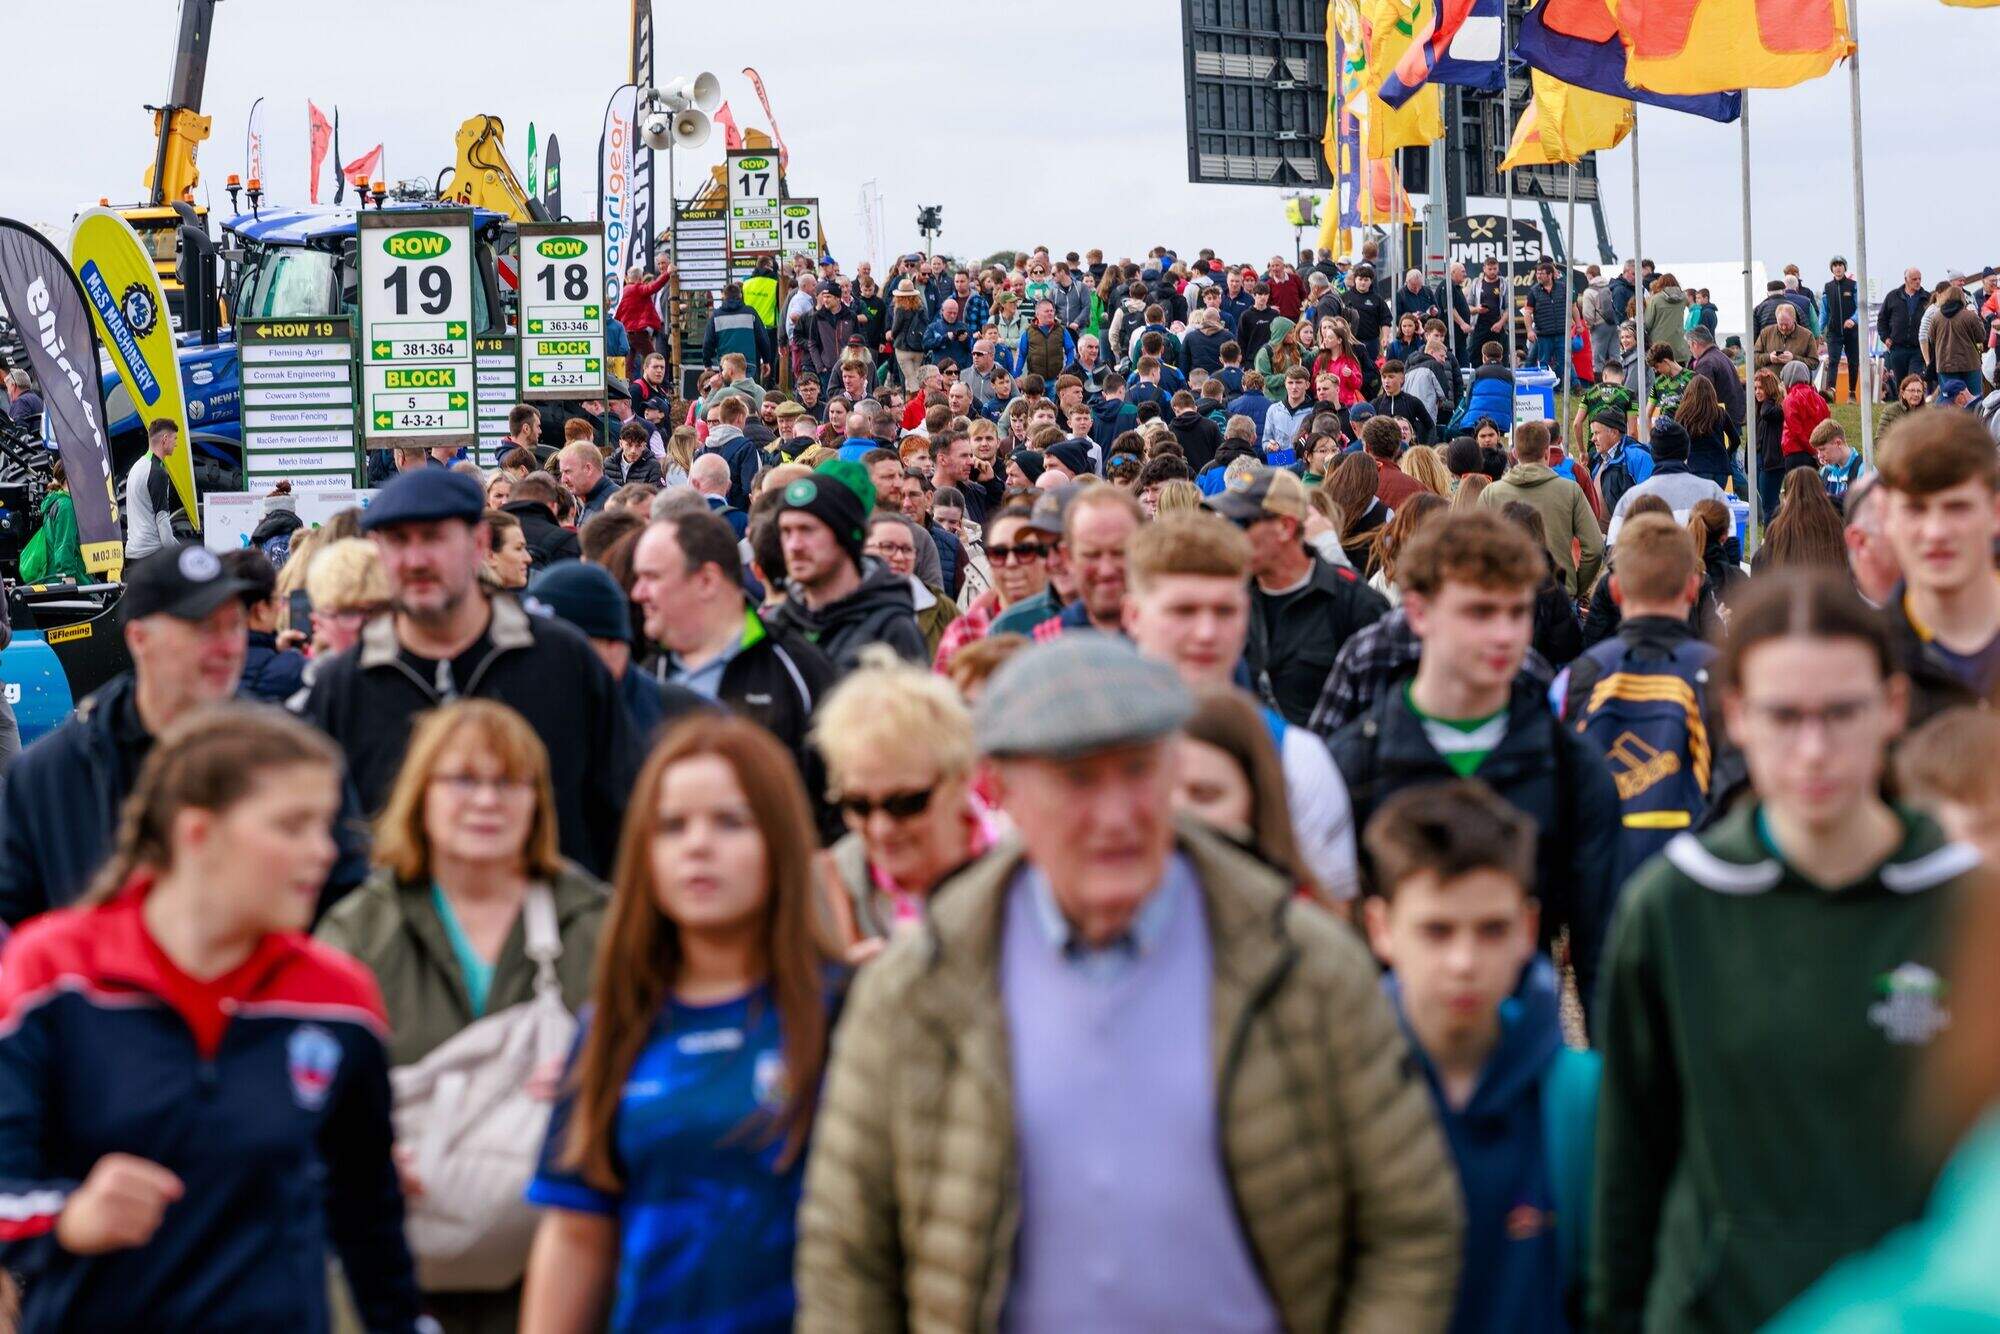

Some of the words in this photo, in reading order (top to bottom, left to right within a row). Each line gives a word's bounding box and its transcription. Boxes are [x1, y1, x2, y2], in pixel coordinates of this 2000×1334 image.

[741, 160, 767, 169] ROW
[605, 110, 625, 266] agrigear
[739, 173, 770, 196] 17
[785, 208, 808, 216] ROW
[740, 221, 772, 229] BLOCK
[783, 220, 810, 239] 16
[390, 237, 443, 255] ROW
[542, 242, 582, 256] ROW
[1450, 239, 1541, 264] UMBLES
[537, 264, 588, 301] 18
[86, 271, 110, 311] M&S
[384, 265, 452, 315] 19
[273, 324, 310, 337] ROW
[315, 323, 333, 336] 19
[550, 321, 588, 331] 363-346
[104, 307, 154, 392] MACHINERY
[403, 343, 454, 355] 381-364
[488, 339, 502, 350] 18
[538, 342, 588, 354] BLOCK
[269, 349, 303, 358] Fleming
[305, 348, 323, 357] Agri
[477, 358, 502, 366] chinery
[557, 362, 563, 370] 5
[253, 371, 285, 380] Cormak
[287, 370, 336, 379] Engineering
[386, 370, 453, 387] BLOCK
[551, 374, 584, 383] 4-3-2-1
[210, 392, 232, 406] NEW
[265, 392, 298, 400] Cowcare
[300, 391, 330, 400] Systems
[408, 397, 416, 408] 5
[270, 413, 299, 422] Brennan
[301, 412, 328, 422] Fencing
[401, 414, 444, 426] 4-3-2-1
[280, 435, 297, 444] Power
[298, 435, 328, 444] Generation
[329, 435, 339, 443] Ltd
[279, 458, 298, 466] Merlo
[299, 457, 323, 465] Ireland
[250, 480, 277, 488] Peninsul
[296, 478, 315, 486] Health
[328, 478, 346, 487] Safety
[57, 626, 90, 639] Fleming
